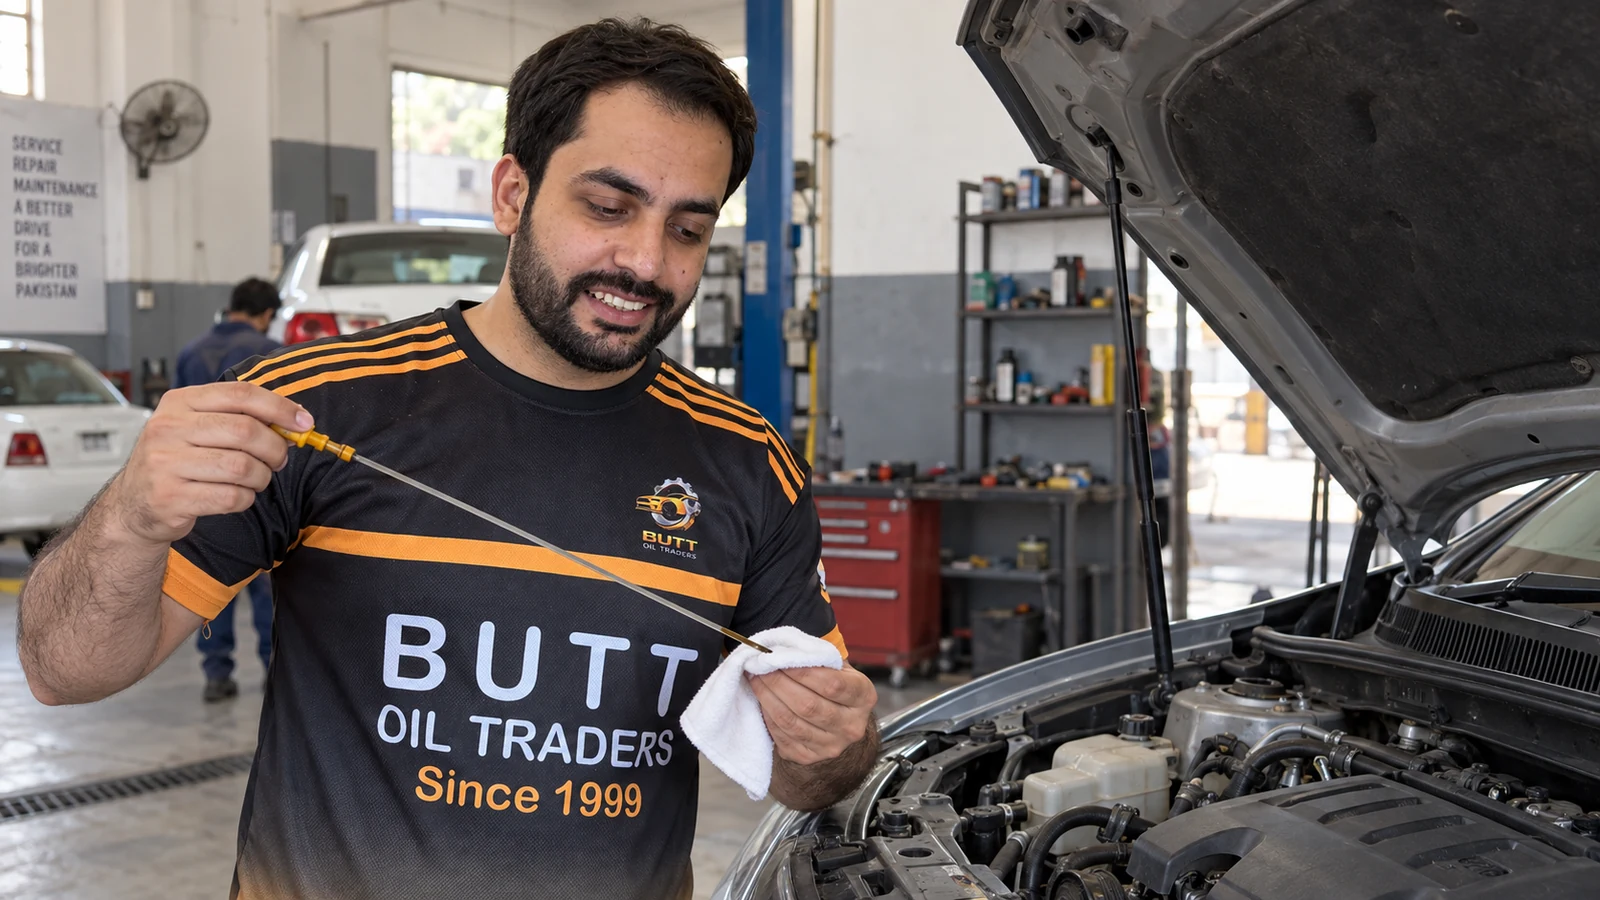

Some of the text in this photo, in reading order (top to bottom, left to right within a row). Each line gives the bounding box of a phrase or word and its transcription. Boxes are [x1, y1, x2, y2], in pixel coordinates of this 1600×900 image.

[12, 135, 63, 154] SERVICE
[13, 156, 57, 174] REPAIR
[13, 177, 98, 198] MAINTENANCE
[14, 199, 73, 217] A BETTER
[14, 220, 51, 237] DRIVE
[15, 240, 52, 257] FOR A
[16, 262, 78, 279] BRIGHTER
[16, 283, 77, 299] PAKISTAN
[642, 530, 698, 551] BUTT
[642, 542, 697, 560] OIL TRADERS
[382, 613, 699, 718] BUTT
[377, 704, 674, 768] OIL TRADERS
[415, 765, 642, 818] Since 1999
